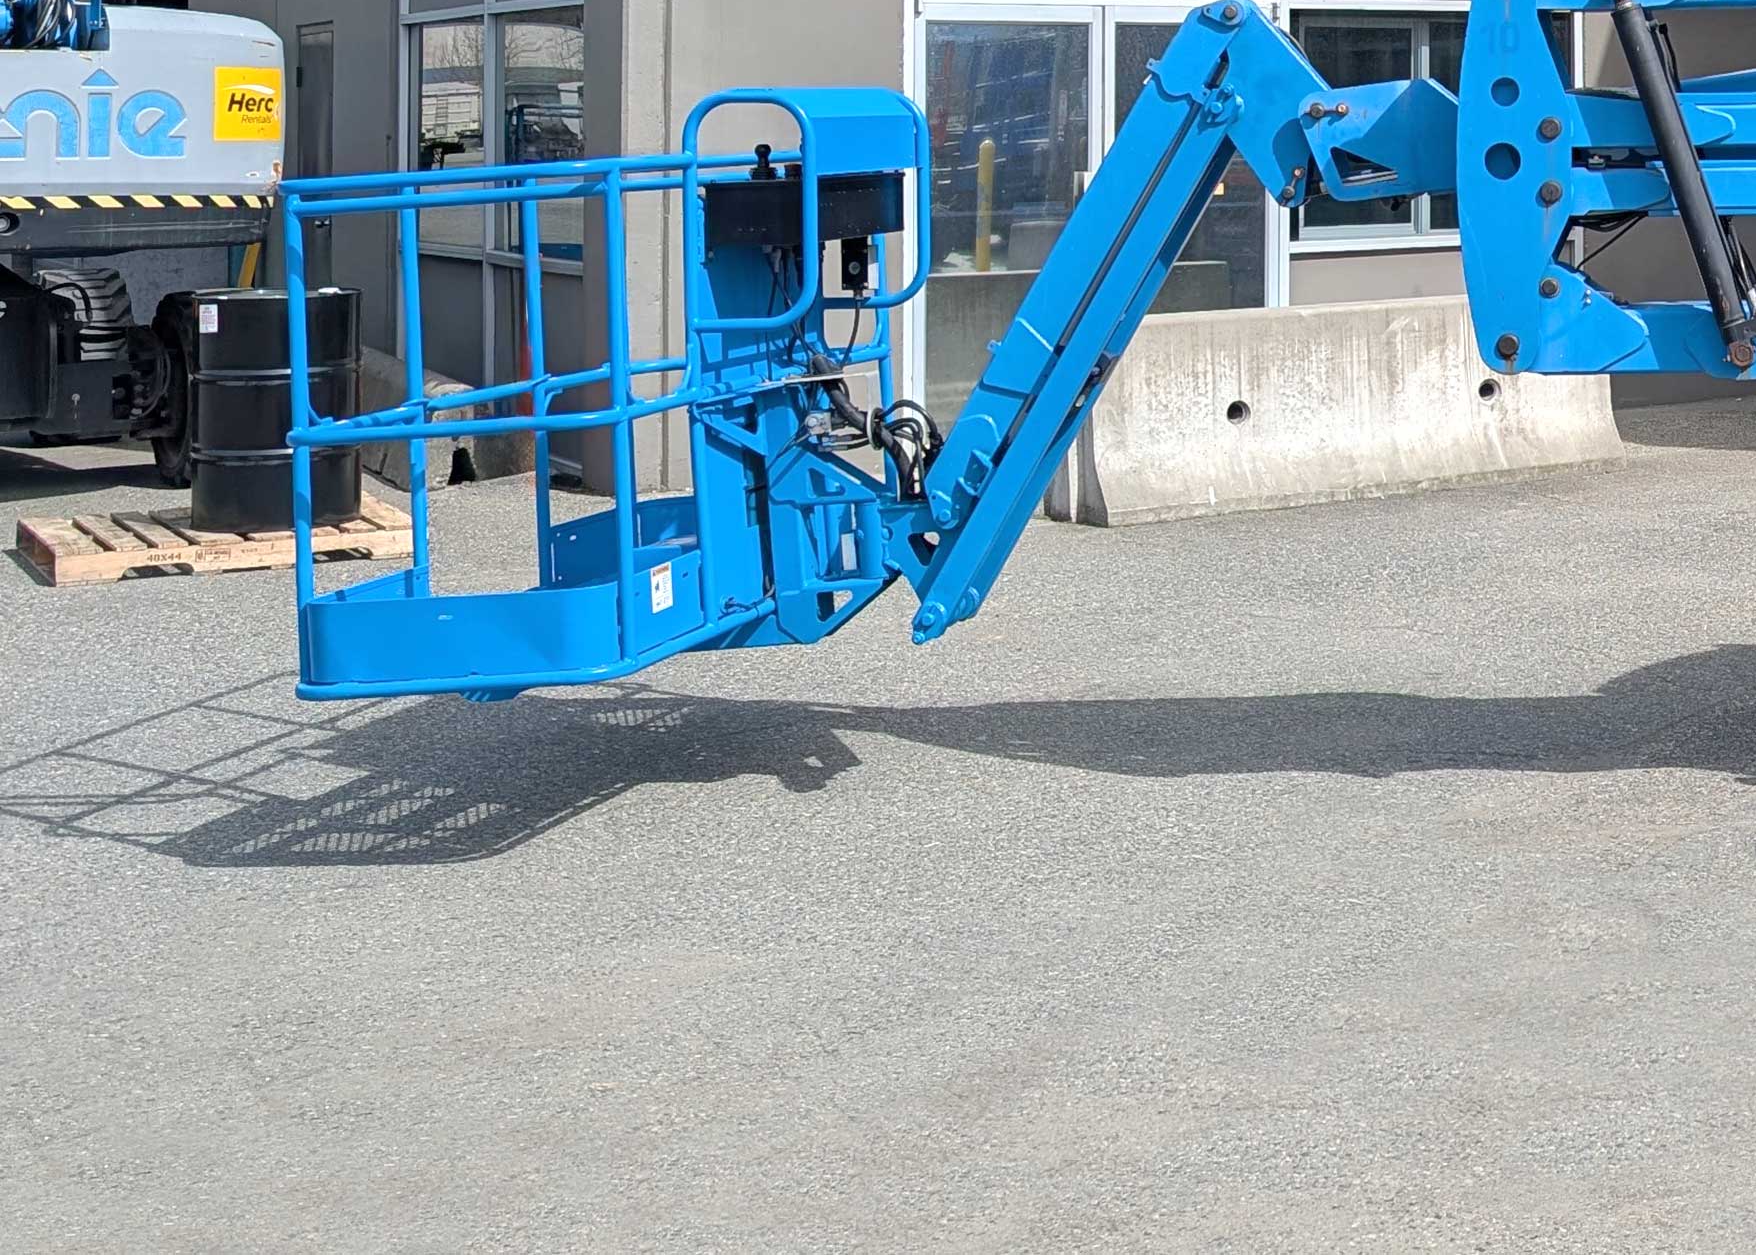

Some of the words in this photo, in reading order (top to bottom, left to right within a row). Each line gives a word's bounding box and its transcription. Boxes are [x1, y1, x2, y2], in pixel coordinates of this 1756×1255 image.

[228, 93, 274, 112] Herc
[0, 67, 187, 159] nie
[241, 114, 272, 124] Rentals
